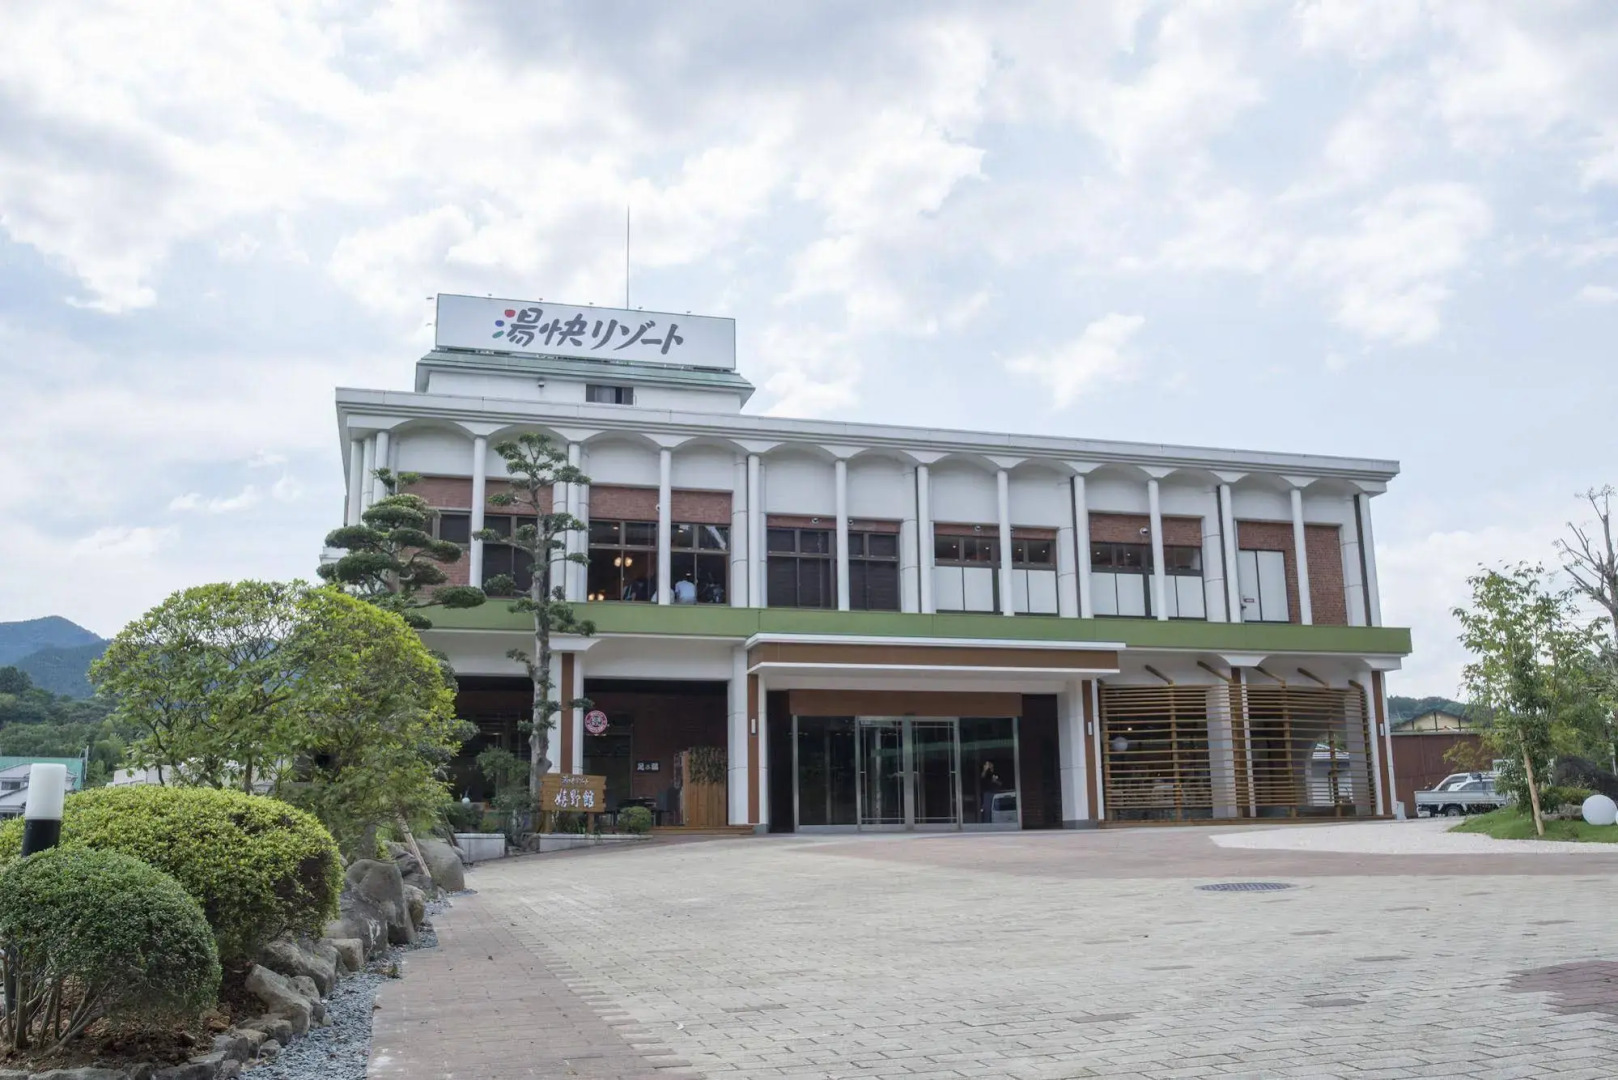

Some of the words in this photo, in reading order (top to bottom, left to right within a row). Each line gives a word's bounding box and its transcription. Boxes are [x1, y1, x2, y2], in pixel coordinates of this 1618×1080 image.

[492, 307, 684, 355] 湯快リゾート
